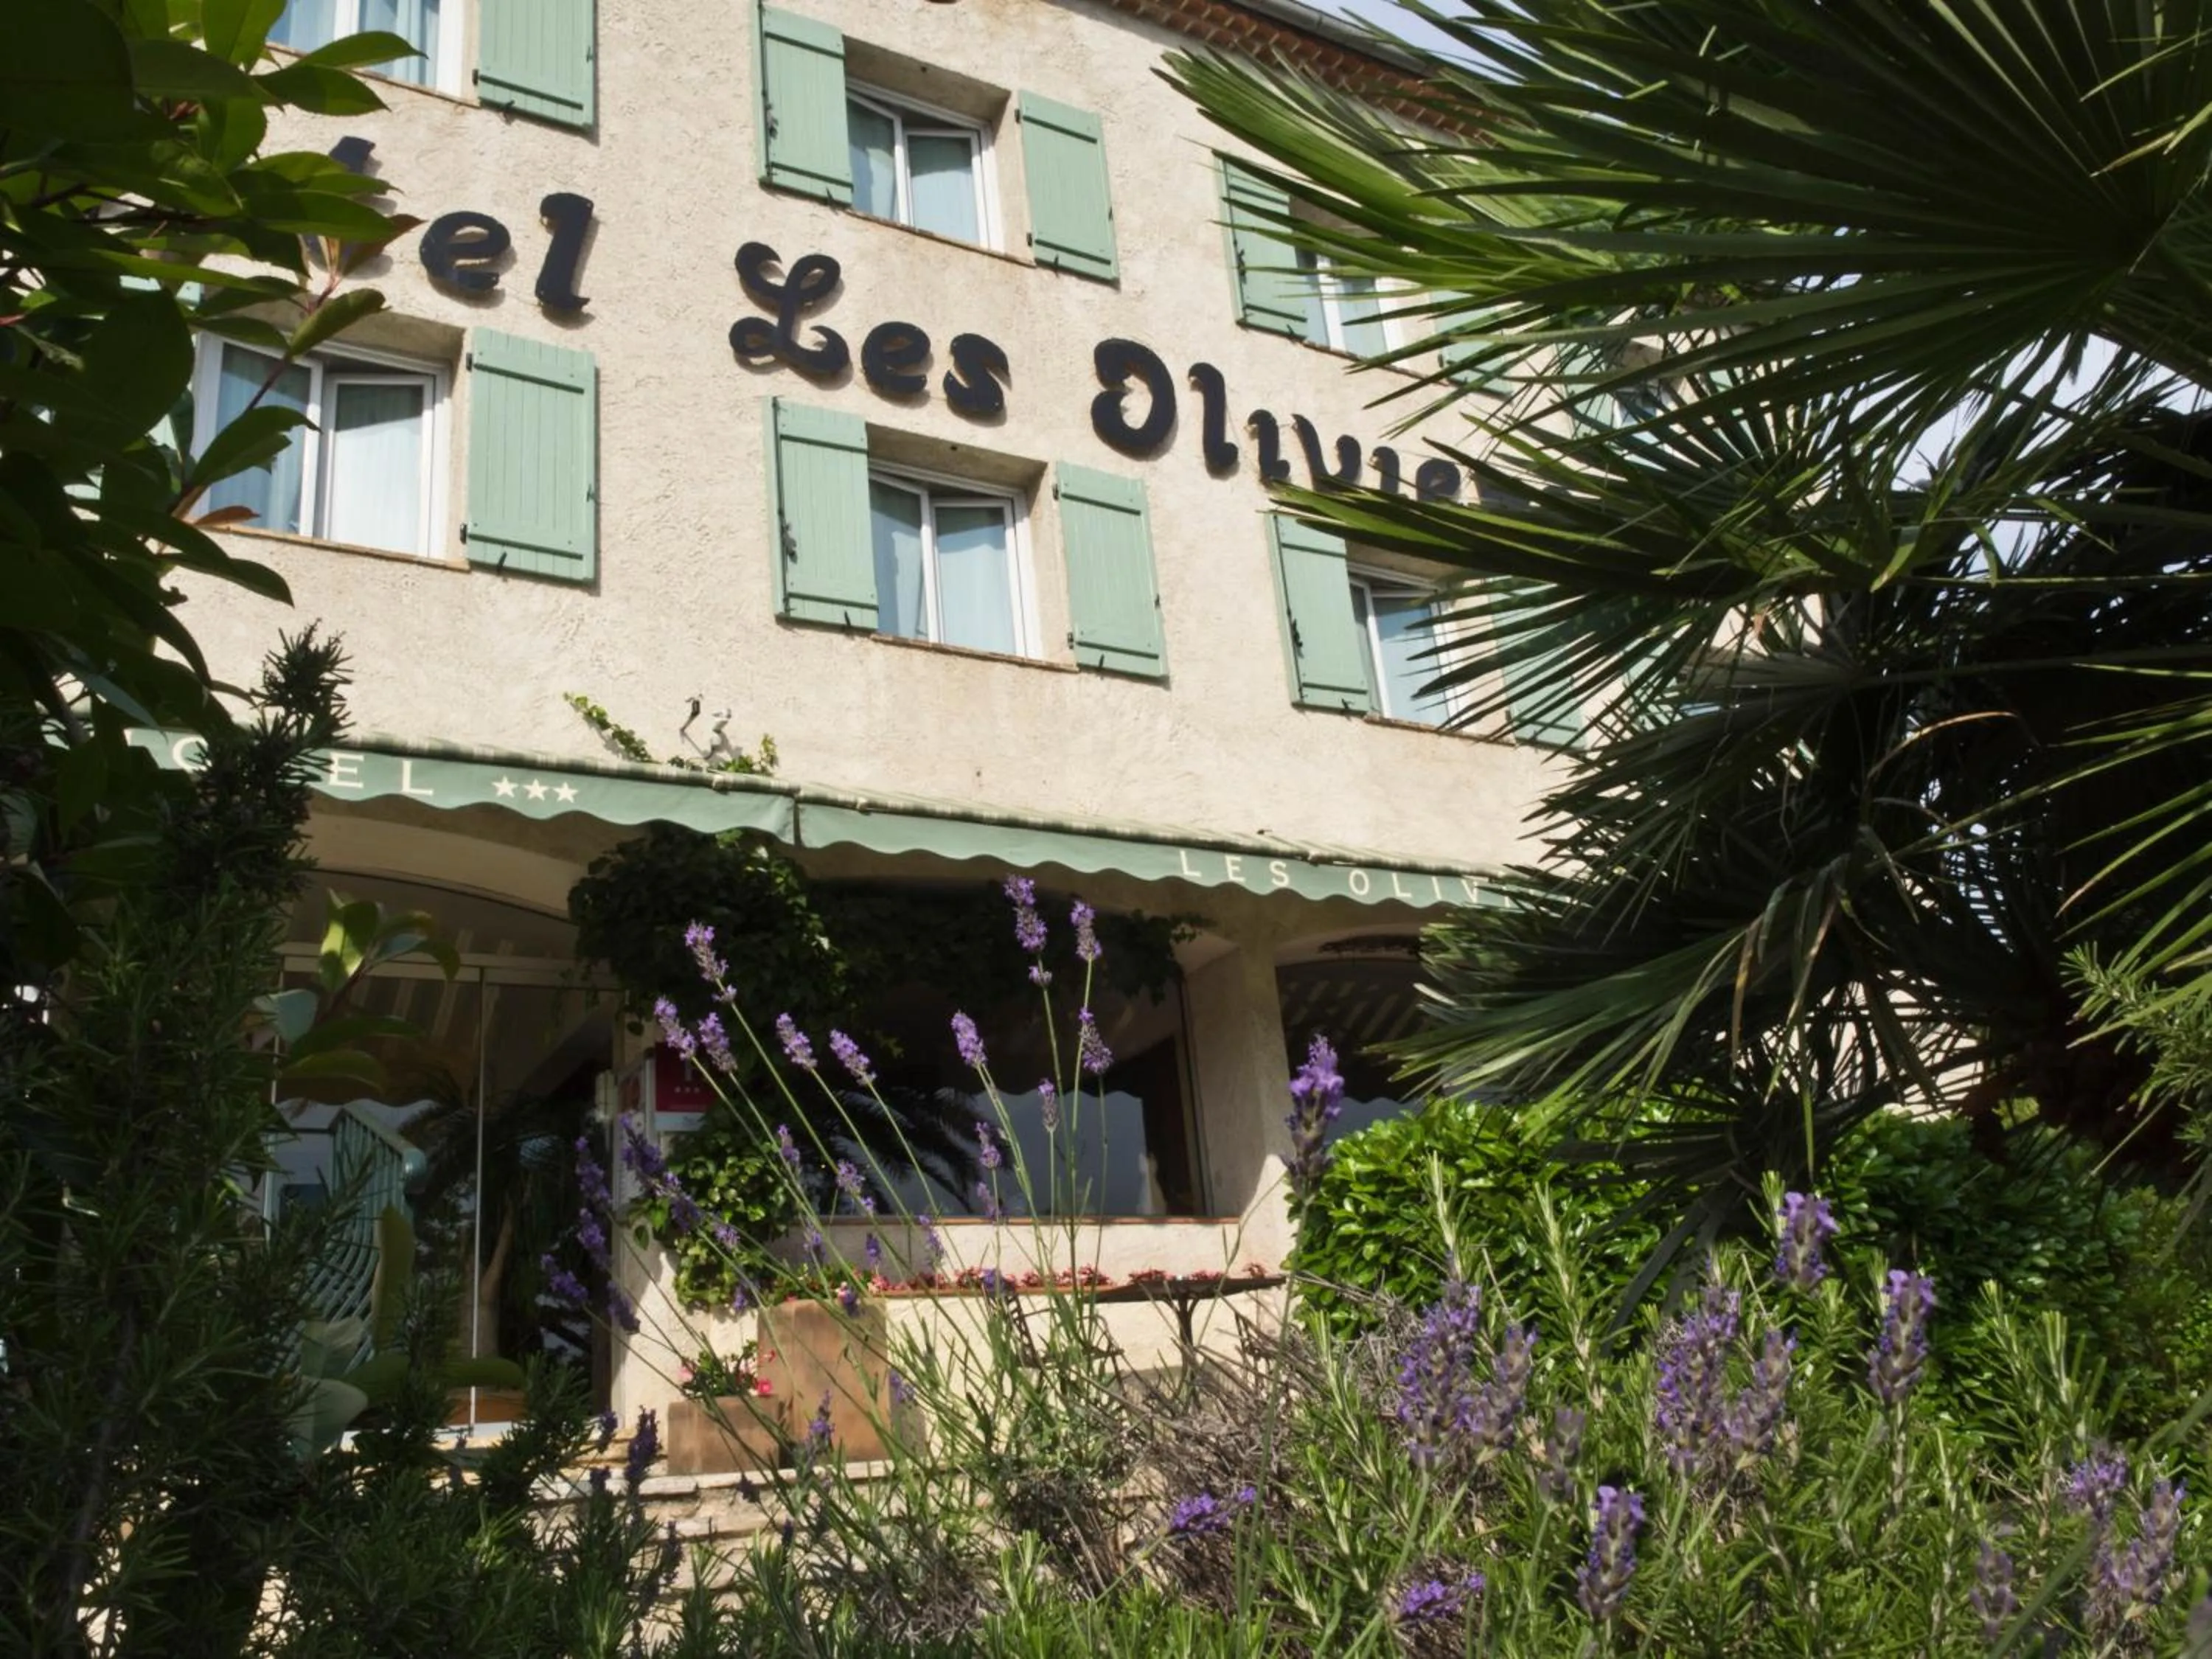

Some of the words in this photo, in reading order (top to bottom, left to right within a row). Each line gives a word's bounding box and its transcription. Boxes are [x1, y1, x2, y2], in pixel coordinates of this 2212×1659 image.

[728, 241, 1011, 415] Les
[1091, 338, 1530, 510] Olivie
[124, 728, 434, 796] OEL
[1180, 849, 1290, 888] LES
